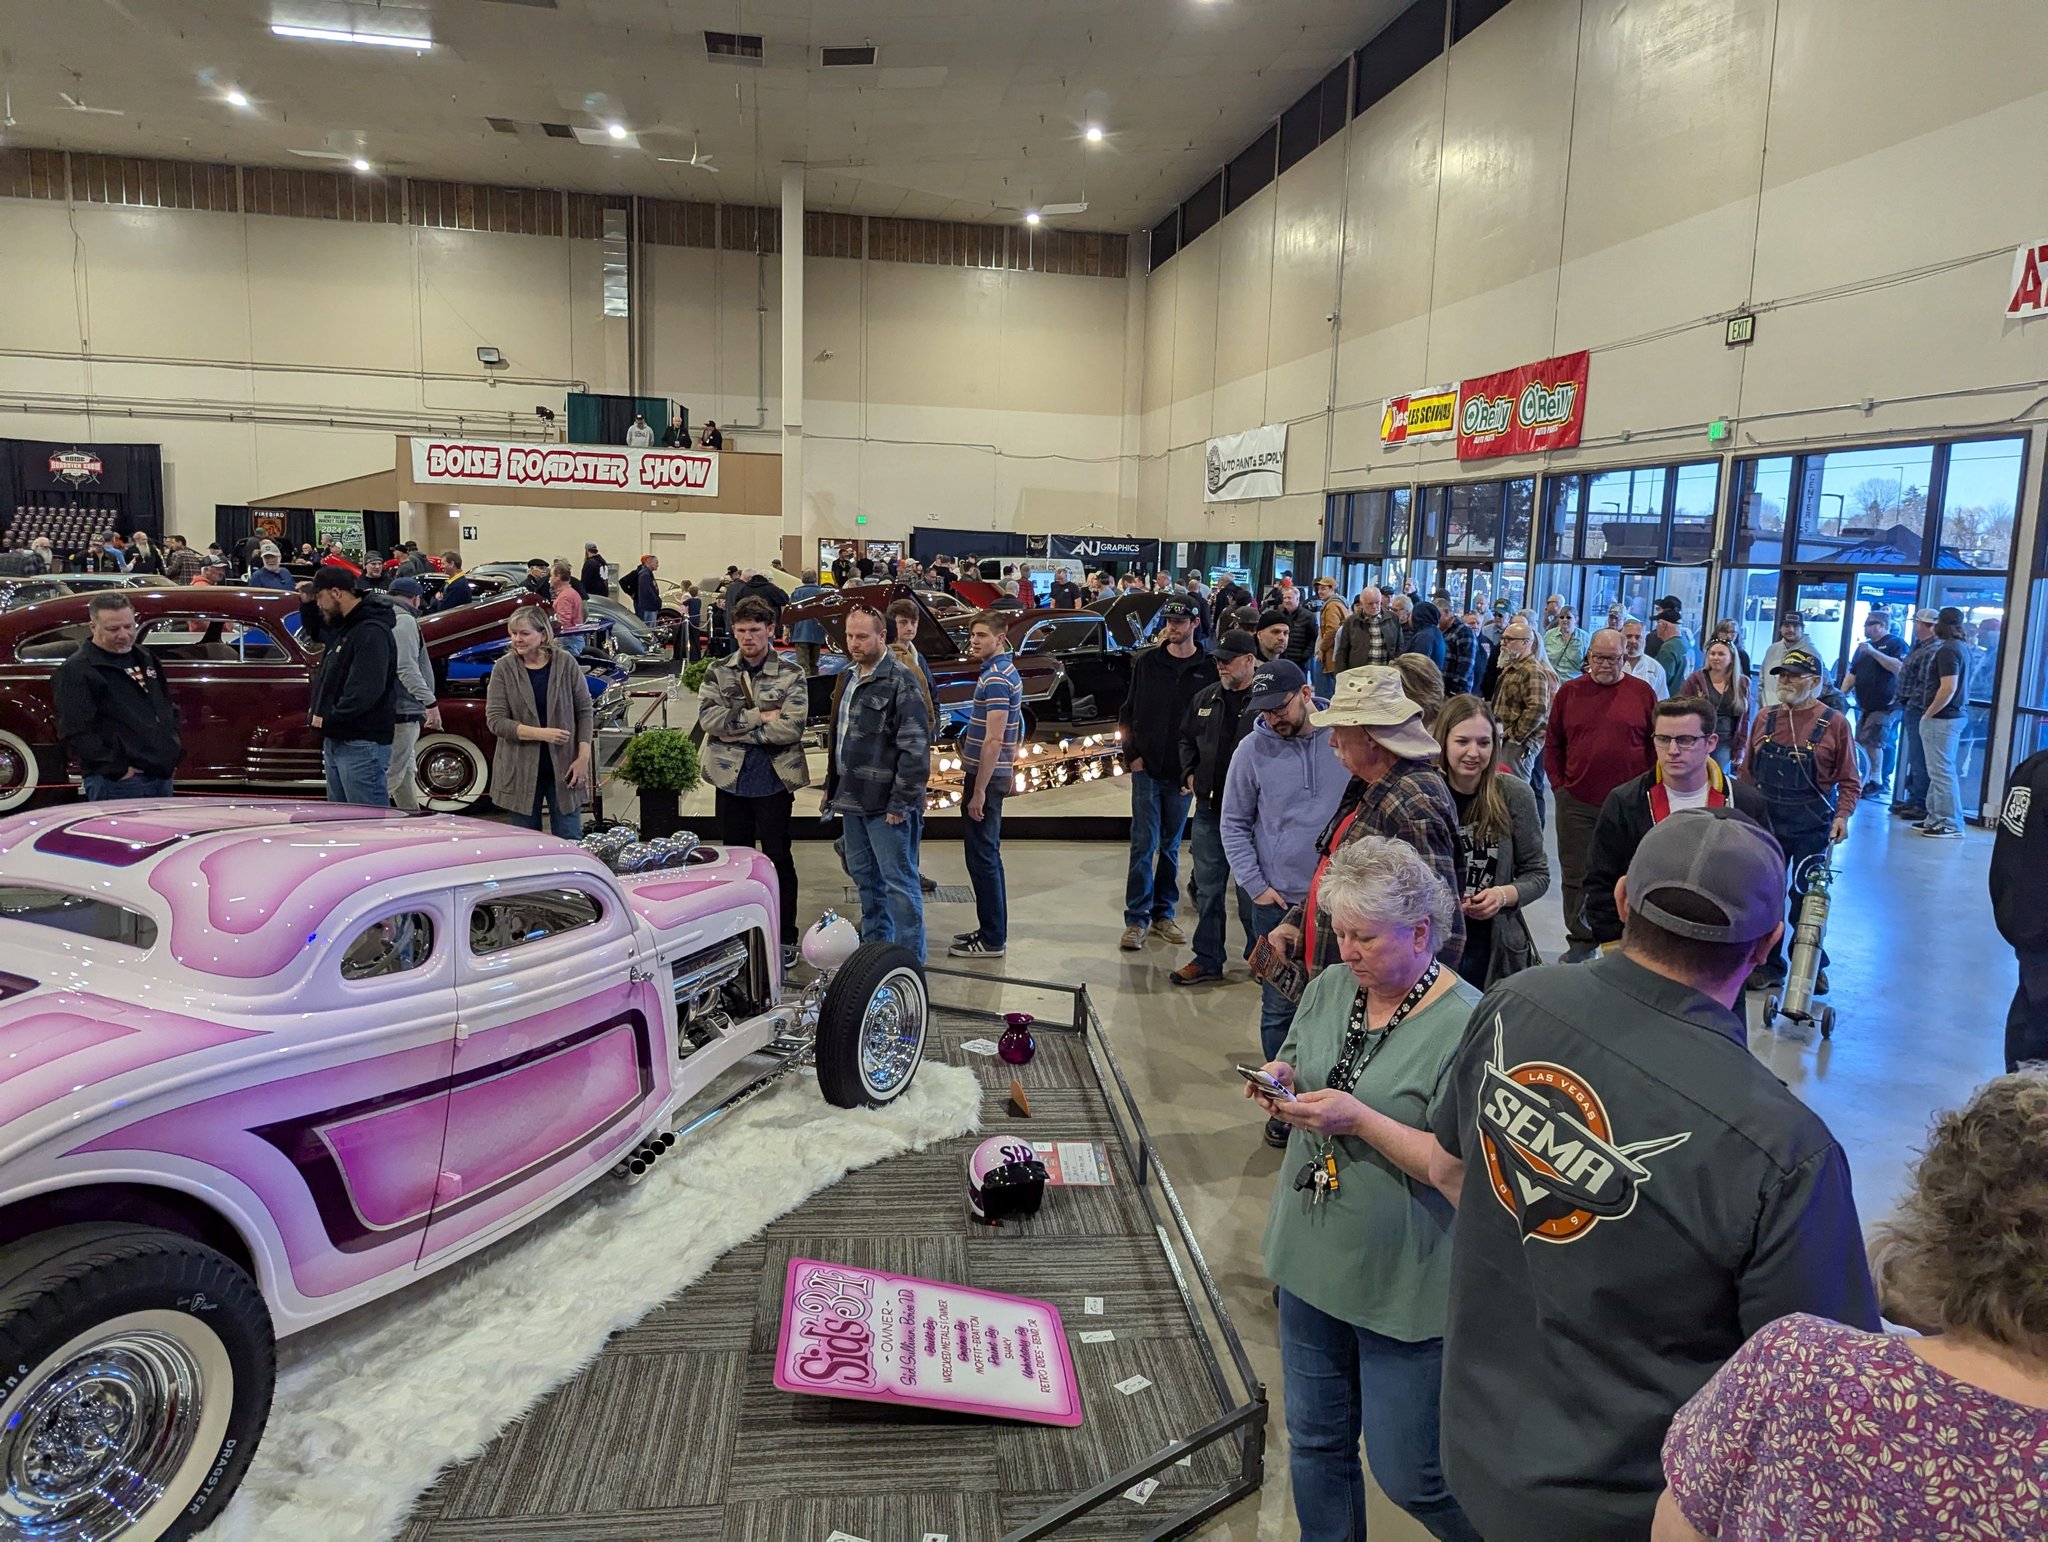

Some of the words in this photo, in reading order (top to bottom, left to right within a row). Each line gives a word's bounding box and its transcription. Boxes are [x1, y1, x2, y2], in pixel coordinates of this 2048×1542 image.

[1732, 320, 1749, 340] EXIT
[1461, 394, 1514, 436] O'Reilly
[1518, 381, 1577, 428] O'Reilly
[1408, 408, 1419, 425] LES
[427, 445, 500, 478] BOISE
[507, 449, 629, 487] ROADSTER
[640, 454, 712, 488] SHOW
[1236, 456, 1253, 470] PAINT
[1258, 451, 1285, 466] SUPPLY
[1805, 473, 1816, 519] CENTER
[1070, 540, 1101, 556] ANJ
[1101, 543, 1140, 552] GRAPHICS
[1529, 1073, 1554, 1082] LAS
[1561, 1080, 1596, 1121] VEGAS
[1484, 1088, 1615, 1194] SEMA
[1000, 1144, 1033, 1165] SID
[798, 1270, 869, 1320] 34
[899, 1305, 915, 1326] Boise
[938, 1299, 949, 1320] OWNER
[881, 1307, 894, 1352] OWNER
[923, 1319, 937, 1331] By
[954, 1321, 969, 1332] By
[985, 1327, 999, 1338] By
[1015, 1326, 1028, 1337] By
[1028, 1319, 1038, 1327] OR
[924, 1332, 936, 1353] Built
[940, 1325, 951, 1350] METALS
[1003, 1337, 1014, 1359] SHAKY
[956, 1336, 971, 1362] Engine
[986, 1341, 1000, 1365] Paint
[1034, 1350, 1046, 1368] RIDES
[899, 1366, 917, 1386] Sid
[942, 1351, 953, 1383] WRECKED
[1038, 1370, 1051, 1393] RETRO
[189, 1439, 237, 1514] DRAGSTER
